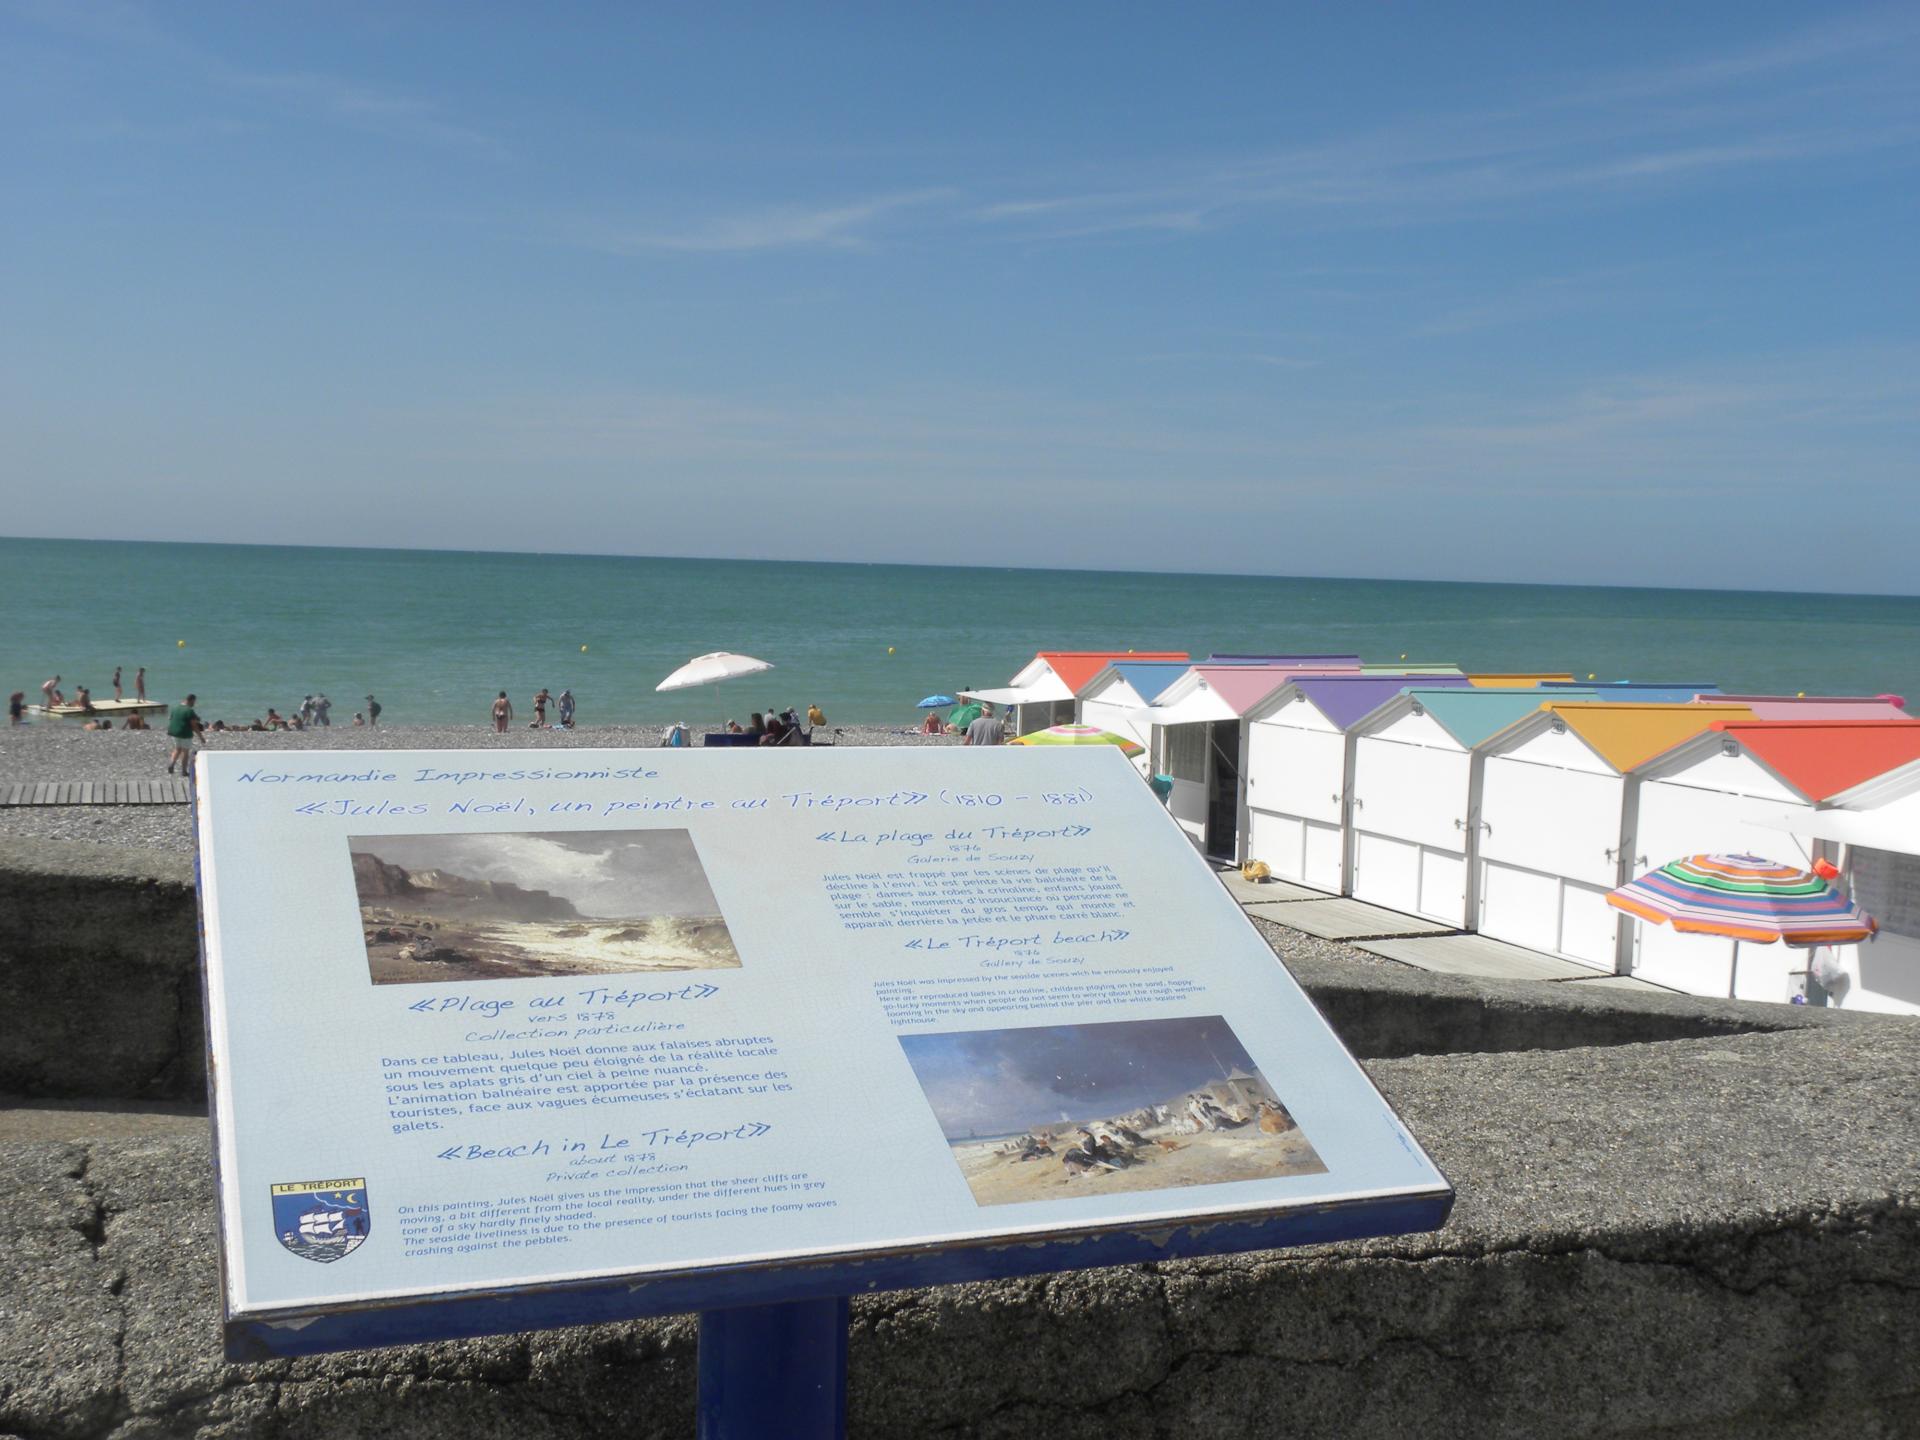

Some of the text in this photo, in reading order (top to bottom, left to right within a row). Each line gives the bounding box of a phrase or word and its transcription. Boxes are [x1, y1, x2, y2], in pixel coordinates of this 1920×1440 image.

[237, 766, 658, 786] Normandie Impressionniste
[448, 797, 535, 816] Noël,
[549, 801, 593, 812] un
[603, 796, 715, 817] peintre
[731, 798, 768, 809] au
[875, 829, 935, 847] plage
[944, 828, 973, 840] du
[906, 852, 1035, 865] Galerie de Souzy
[957, 933, 1041, 951] Tréport
[979, 959, 1024, 969] Gallery
[1045, 956, 1085, 966] Souzy
[528, 995, 566, 1009] au
[527, 1011, 615, 1024] vers 1878
[464, 1020, 685, 1042] Collection particulière
[381, 1036, 774, 1068] Dans ce tableau, Jules Noël donne aux falaises abruptes
[383, 1046, 778, 1080] un mouvement quelque peu éloigné de la réalité locale
[385, 1063, 709, 1093] sous les aplats gris d'un ciel à peine nuancé.
[387, 1070, 788, 1106] L'animation balnéaire est apportée par la présence des
[389, 1082, 793, 1119] touristes, face aux vagues écumeuses s'éclatant sur les
[391, 1121, 445, 1135] galets.
[562, 1138, 587, 1153] in
[599, 1133, 630, 1150] Le
[568, 1152, 656, 1166] about 1878
[545, 1163, 689, 1183] Private collection
[280, 1183, 295, 1192] LE
[397, 1205, 415, 1215] On
[417, 1203, 440, 1213] this
[442, 1200, 494, 1213] painting,
[498, 1196, 527, 1207] Jules
[529, 1193, 554, 1204] Noël
[557, 1192, 586, 1203] gives
[603, 1188, 622, 1197] the
[625, 1183, 683, 1196] impression
[684, 1180, 707, 1190] that
[710, 1179, 729, 1188] the
[731, 1177, 759, 1186] sheer
[762, 1173, 789, 1183] cliffs
[791, 1172, 809, 1180] are
[401, 1210, 597, 1236] tone of a sky hardly finely shaded.
[404, 1234, 573, 1257] crashing against the pebbles.
